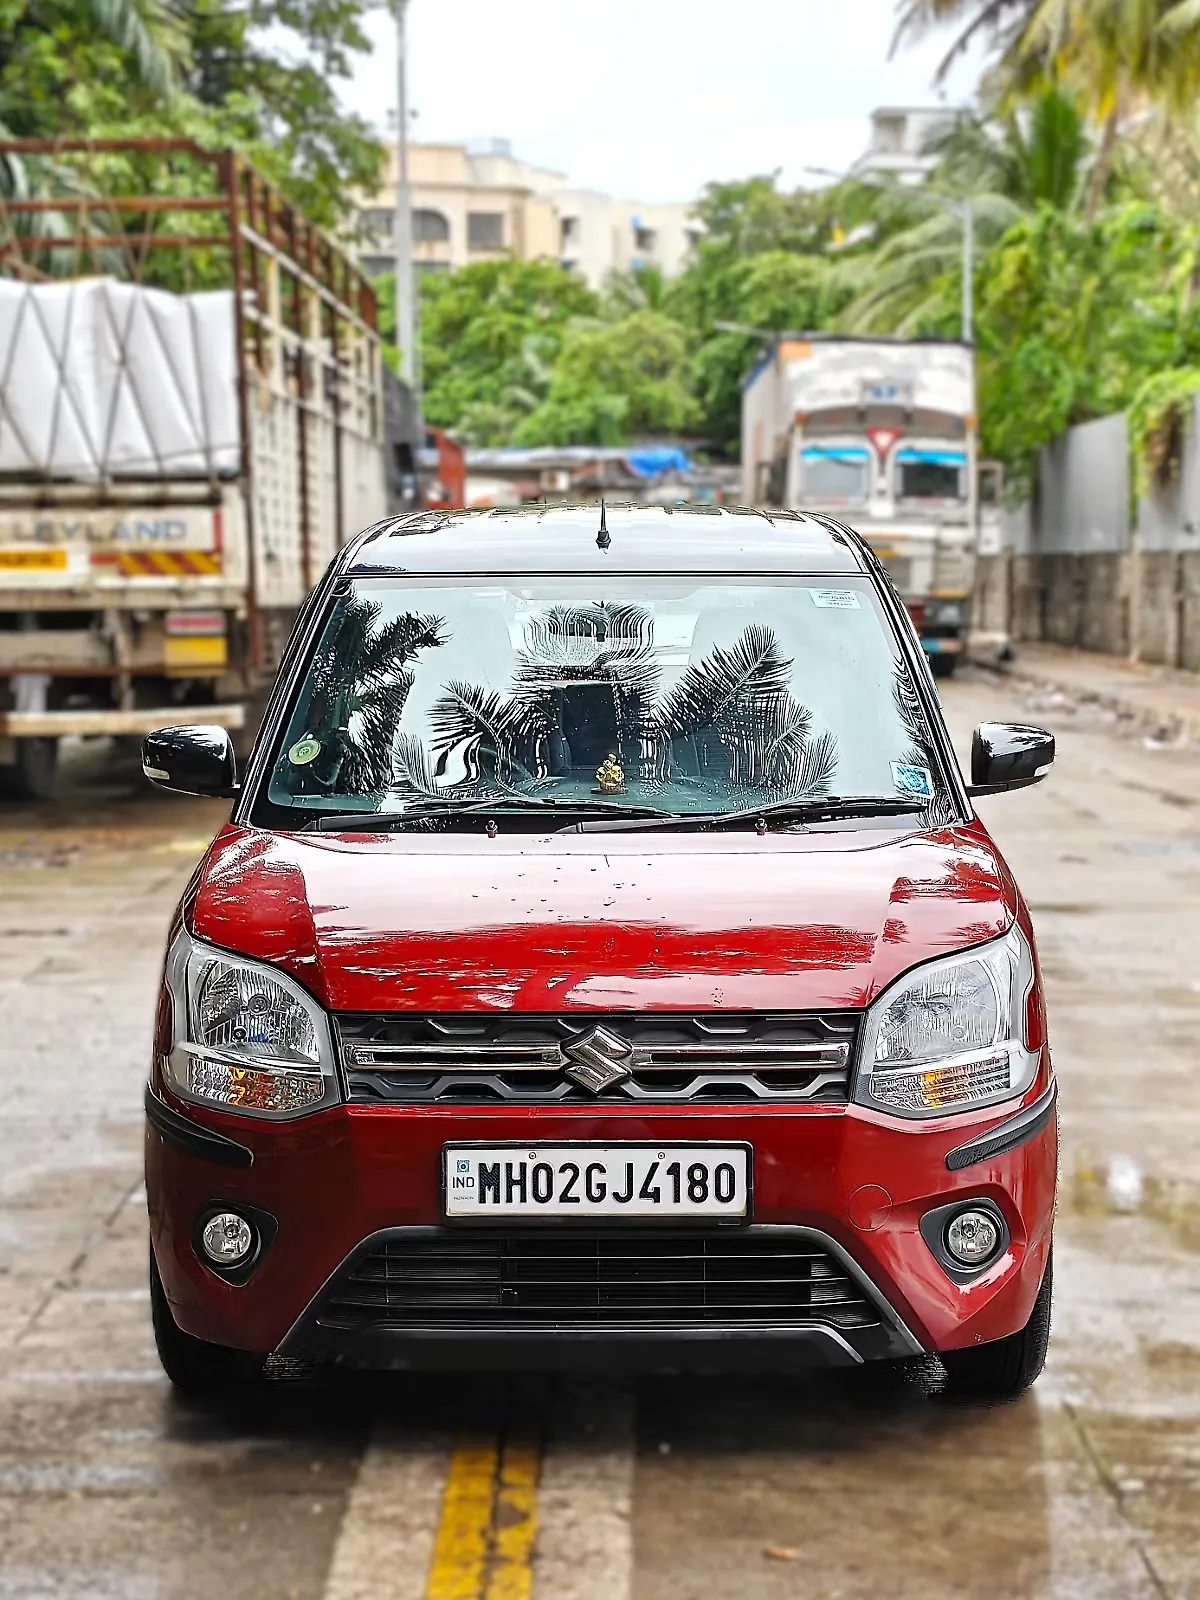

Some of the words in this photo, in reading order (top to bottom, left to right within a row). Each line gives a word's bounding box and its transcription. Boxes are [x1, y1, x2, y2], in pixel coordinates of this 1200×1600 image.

[13, 519, 187, 541] LEYLAND
[453, 1177, 475, 1188] IND
[478, 1161, 736, 1204] MH02GJ4180
